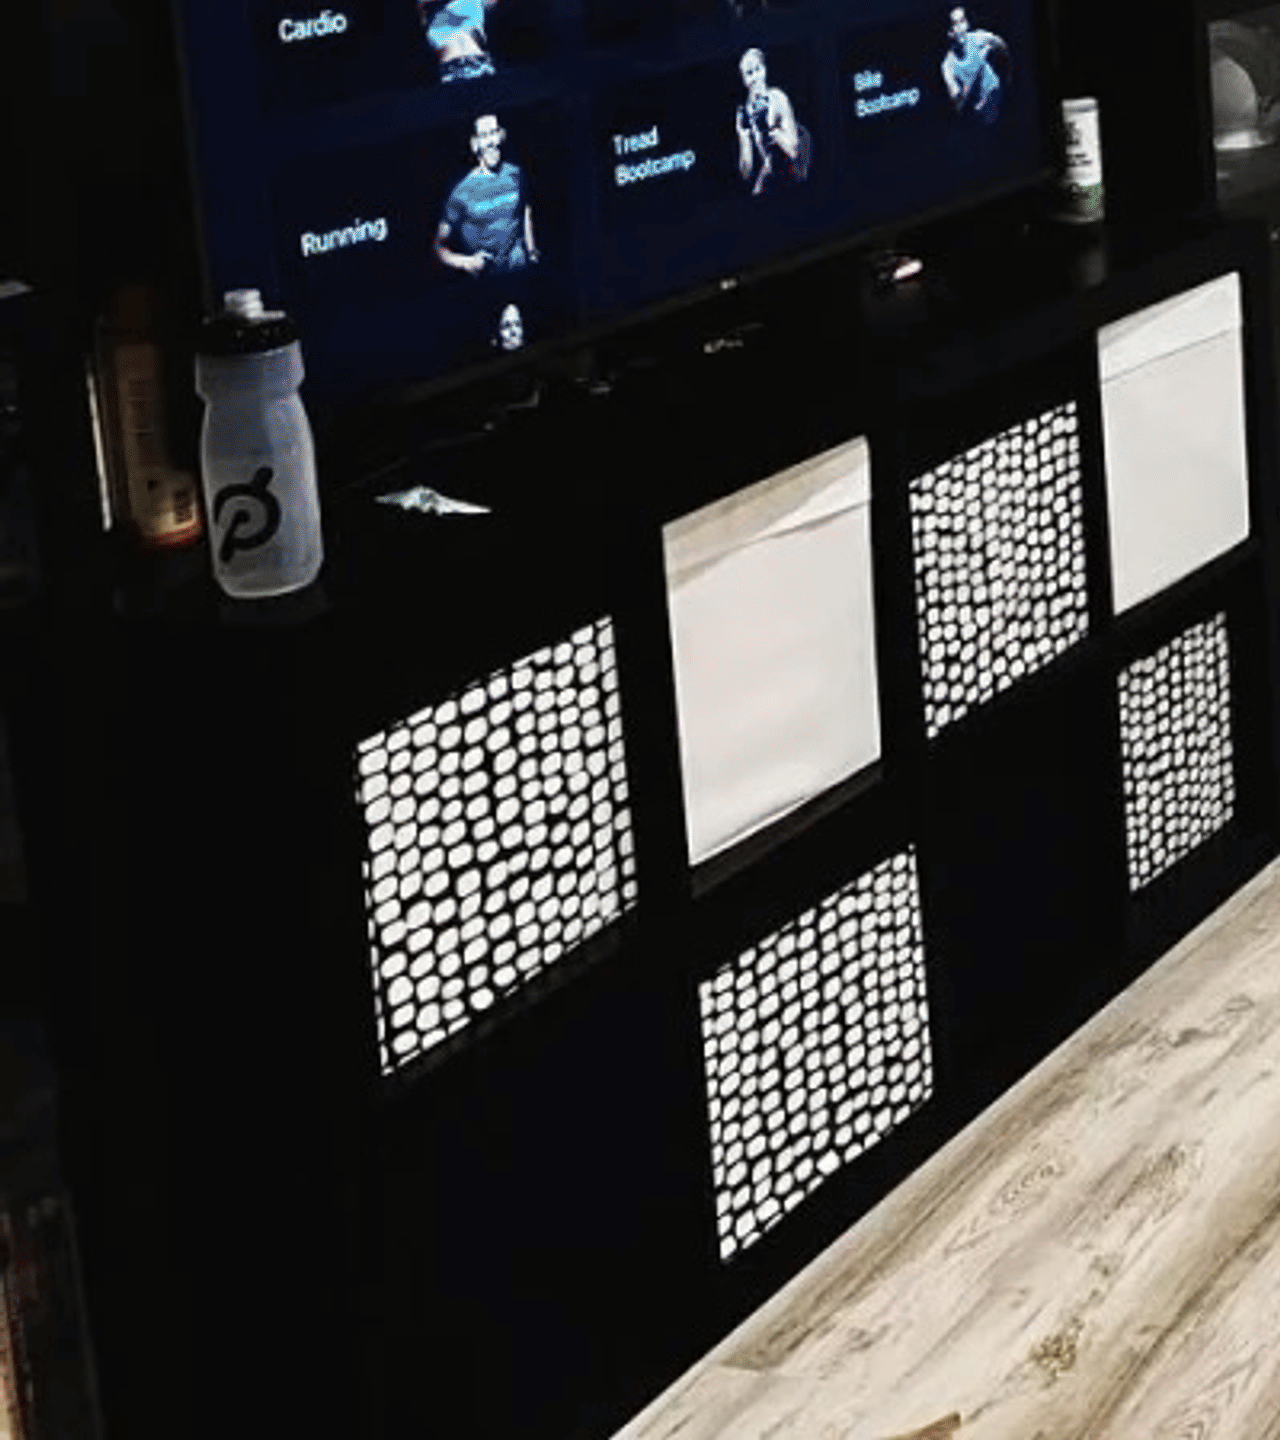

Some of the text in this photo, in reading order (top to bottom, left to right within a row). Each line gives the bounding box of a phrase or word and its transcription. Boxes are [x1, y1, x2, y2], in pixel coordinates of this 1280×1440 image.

[278, 9, 348, 42] Cardio
[853, 69, 883, 92] Bike
[855, 86, 920, 118] Bootcamp
[612, 124, 659, 155] Tread
[614, 149, 696, 186] Bootcamp
[300, 216, 388, 257] Running
